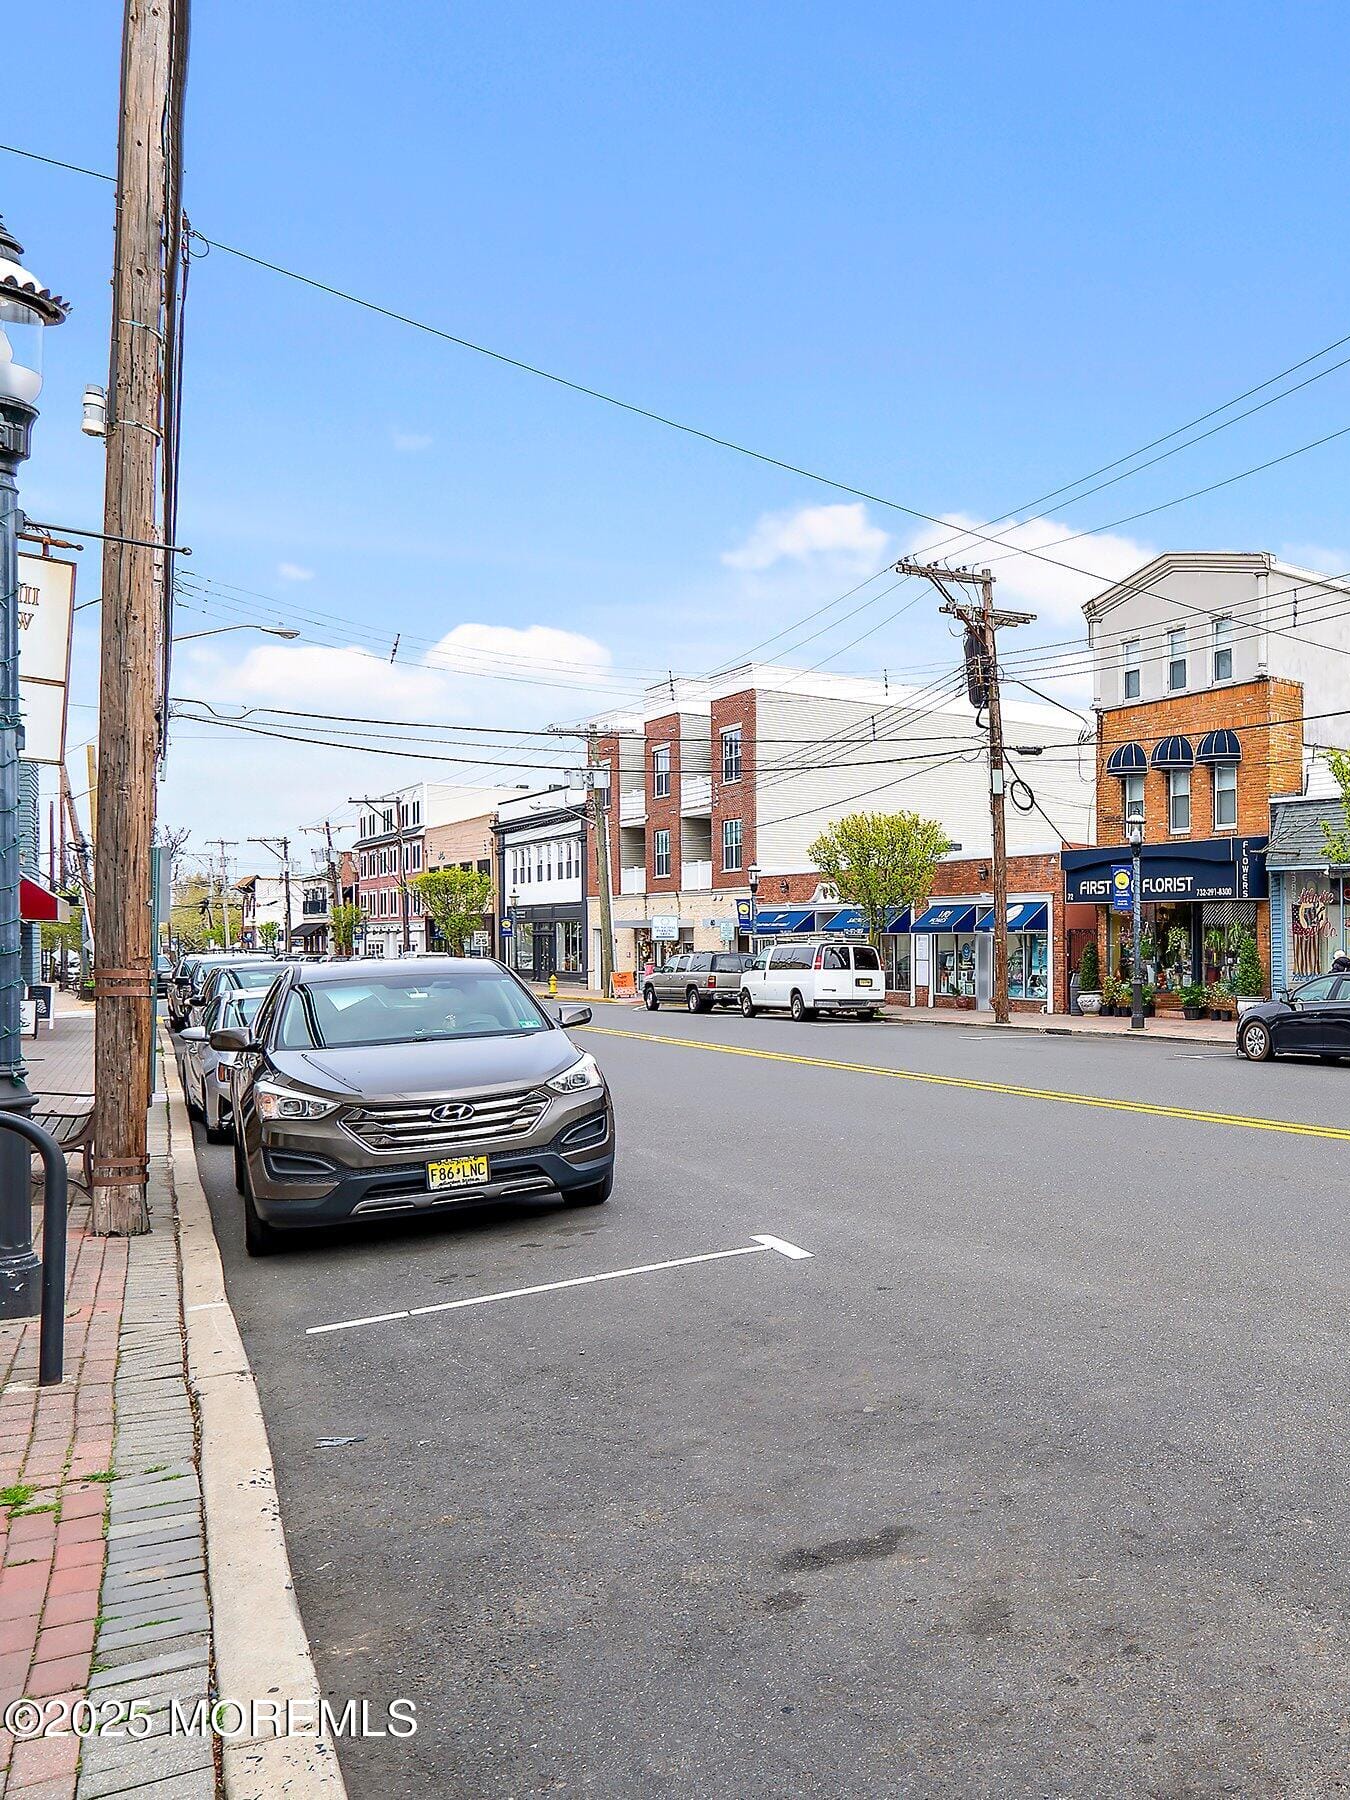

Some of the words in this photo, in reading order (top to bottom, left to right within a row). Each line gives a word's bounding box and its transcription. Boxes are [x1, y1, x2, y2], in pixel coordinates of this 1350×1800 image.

[1241, 840, 1250, 898] FLOWERS
[1079, 880, 1112, 895] FIRST
[1141, 876, 1194, 894] FLORIST
[1196, 888, 1233, 897] 732-291-8300
[1067, 893, 1074, 901] 72
